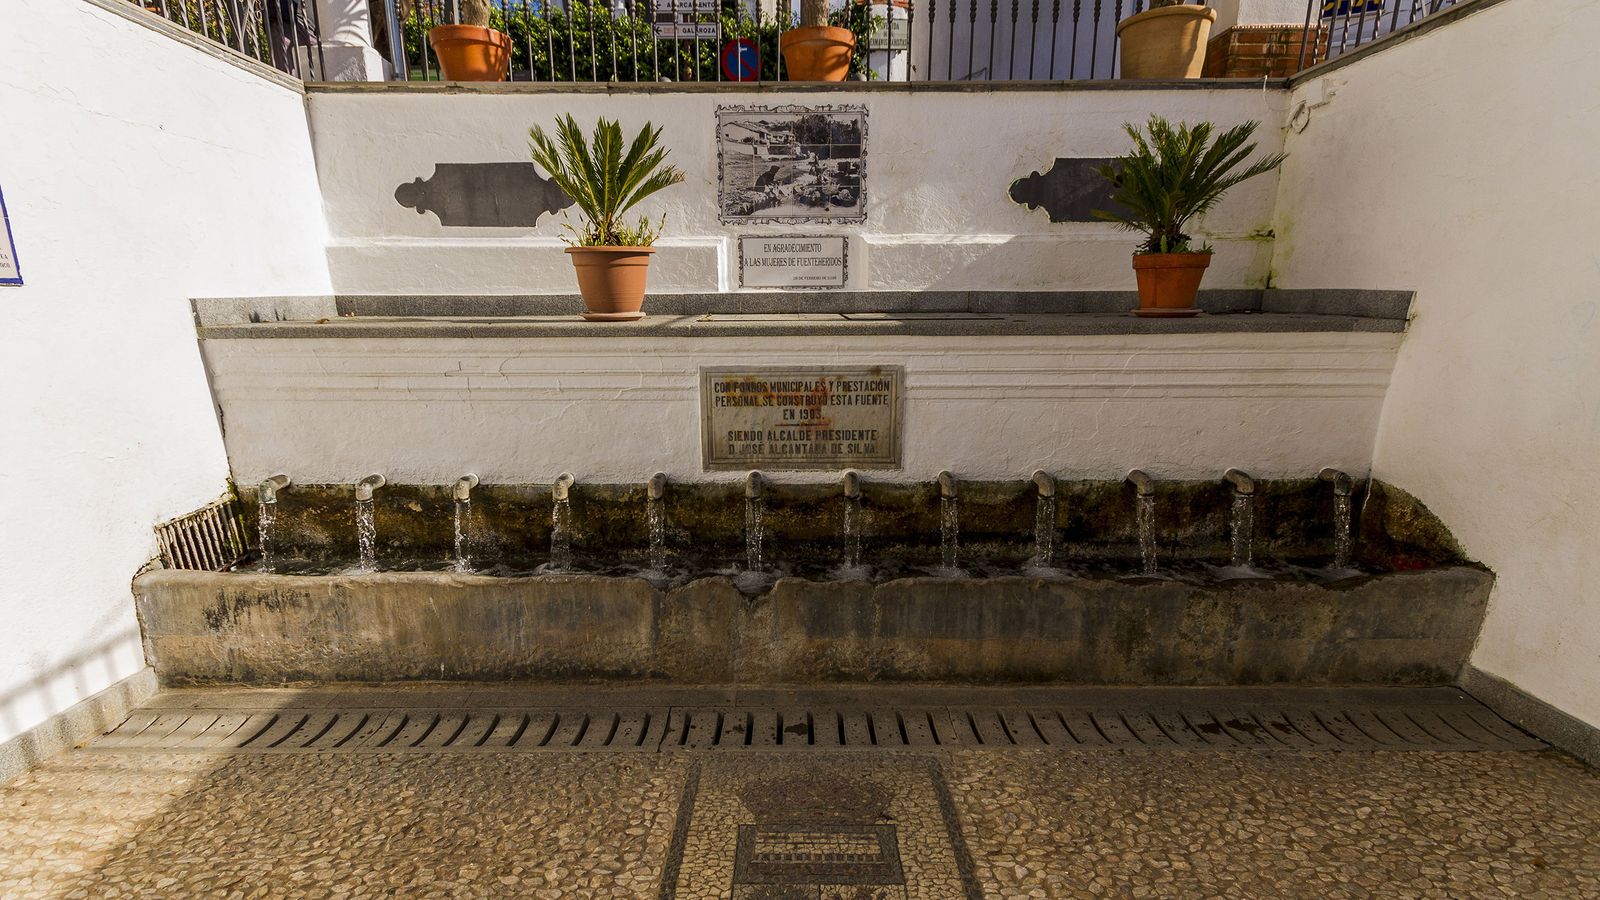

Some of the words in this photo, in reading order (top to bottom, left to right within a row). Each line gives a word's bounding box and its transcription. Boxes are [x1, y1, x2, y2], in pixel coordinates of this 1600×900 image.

[763, 243, 772, 253] EN
[773, 243, 822, 253] AGRADECIMIENTO
[744, 257, 750, 267] A
[750, 257, 761, 267] LAS
[762, 257, 787, 267] MUJERES
[788, 257, 796, 267] DE
[797, 256, 842, 267] FUENTEHERIDOS
[714, 382, 731, 393] CON
[733, 382, 768, 393] FONDOS
[770, 381, 825, 393] MUNICIPALES
[829, 381, 836, 392] Y
[837, 378, 890, 392] PRESTACIÓN
[776, 395, 828, 407] CONSTRUYO
[830, 395, 853, 406] ESTA
[855, 395, 889, 406] FUENTE
[783, 409, 795, 420] EN
[728, 431, 763, 442] SIENDO
[767, 430, 811, 442] ALCALDE
[815, 429, 878, 441] PRESIDENTE
[769, 443, 827, 455] ALCANTARA
[831, 443, 843, 454] DE
